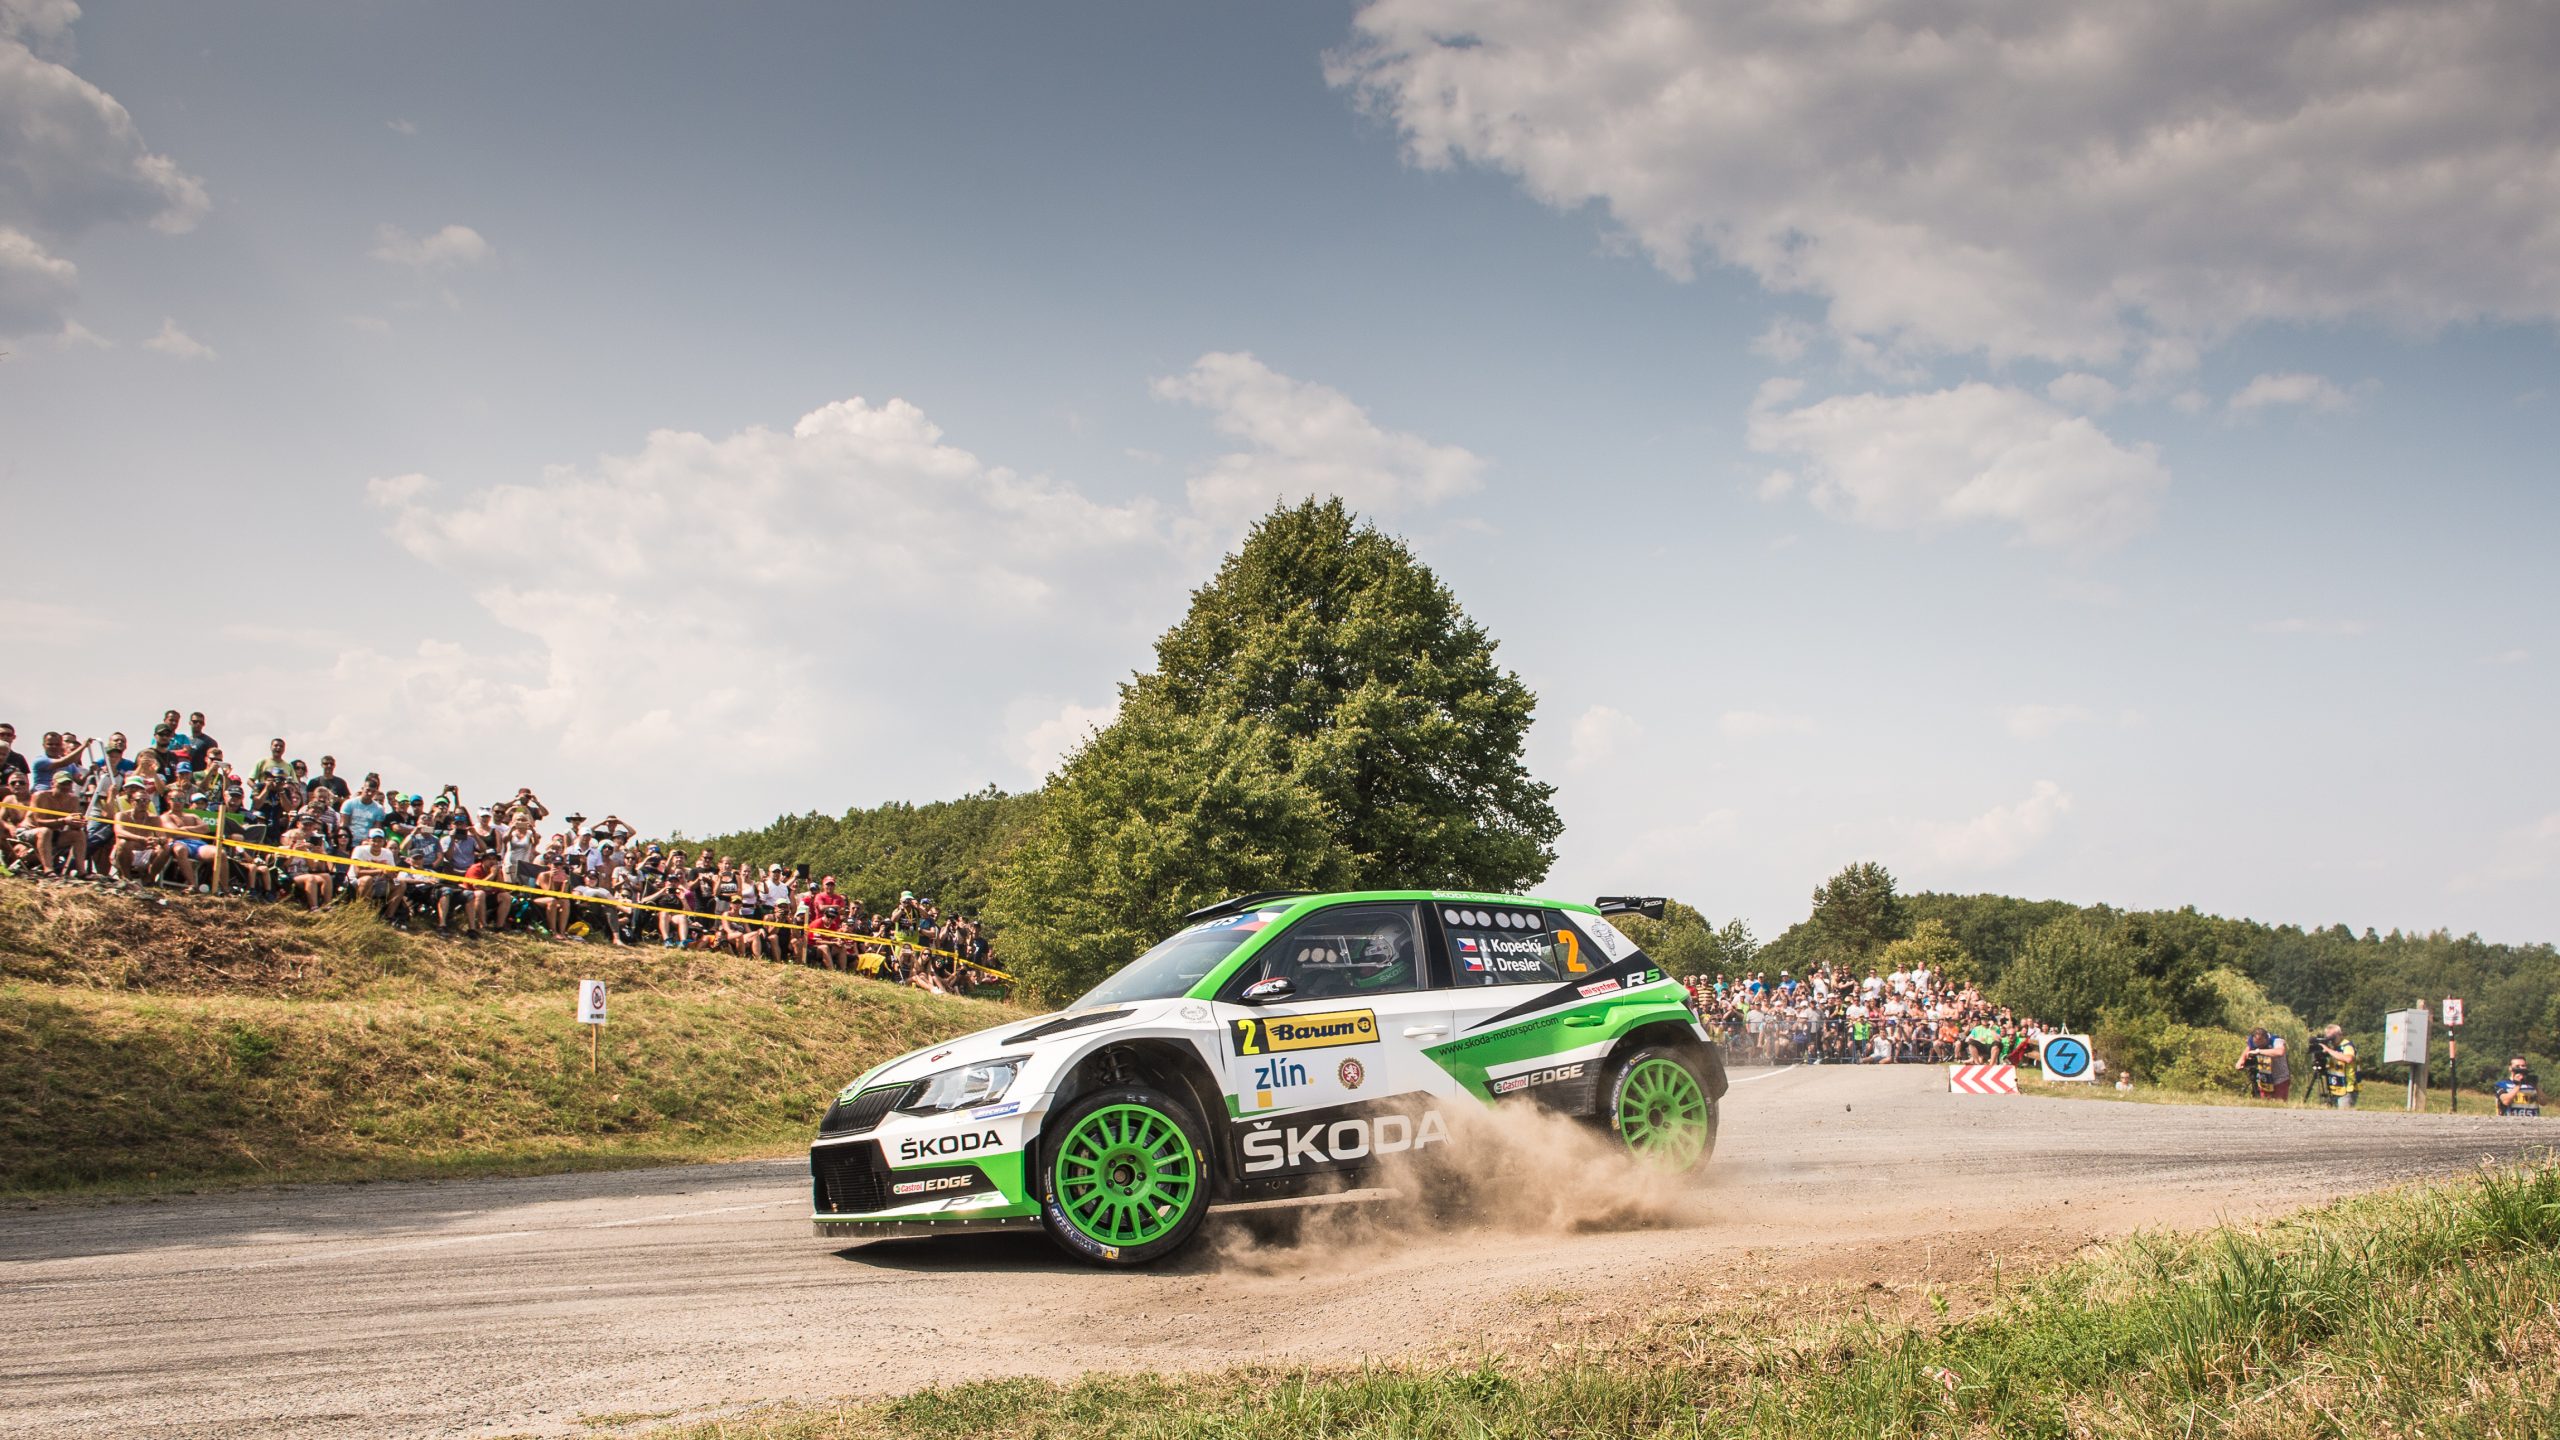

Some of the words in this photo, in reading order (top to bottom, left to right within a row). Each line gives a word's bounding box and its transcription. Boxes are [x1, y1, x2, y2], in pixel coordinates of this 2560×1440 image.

[1478, 938, 1491, 953] J.
[1490, 938, 1542, 956] Kopecký
[1557, 929, 1588, 973] 2
[1483, 957, 1497, 971] P.
[1496, 957, 1541, 972] Dresler
[1626, 968, 1660, 988] R5
[1237, 1019, 1260, 1055] 2
[1270, 1022, 1354, 1041] Barum
[1438, 1016, 1559, 1056] www.skoda-motorsport.com
[1502, 1077, 1528, 1091] Castrol
[1529, 1063, 1585, 1087] EDGE
[900, 1129, 1004, 1161] ŠKODA
[1243, 1110, 1455, 1173] ŠKODA
[900, 1183, 923, 1193] Castrol
[926, 1174, 973, 1192] EDGE
